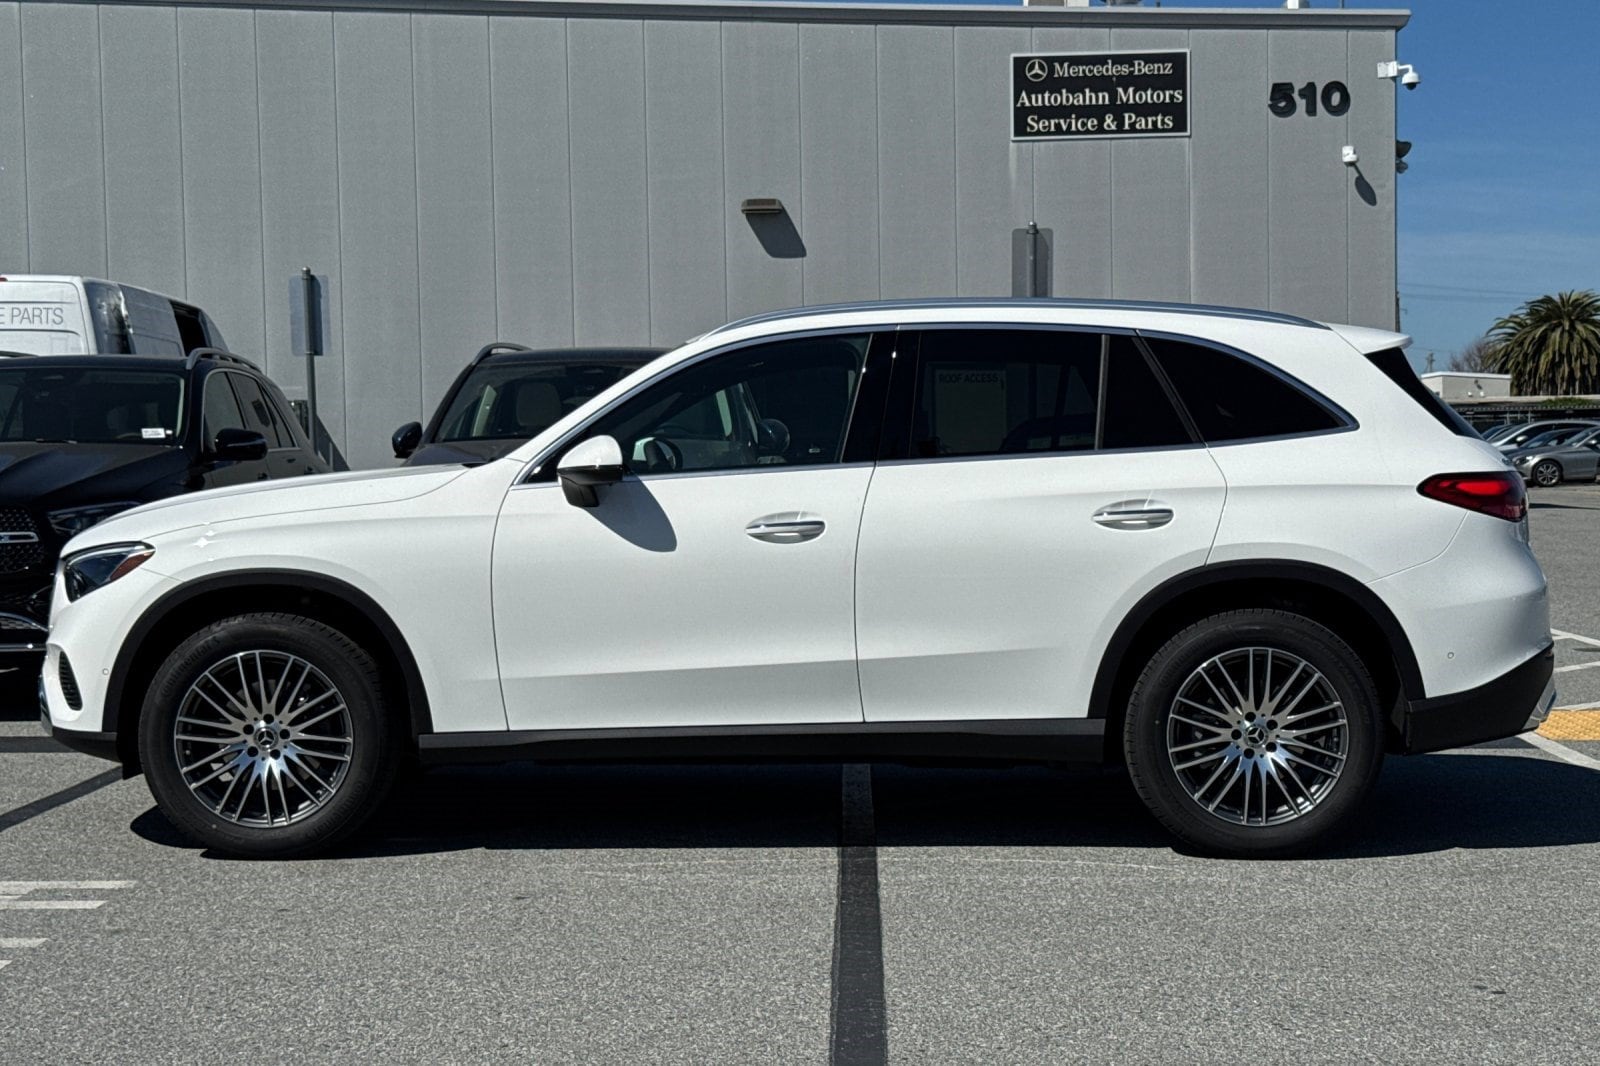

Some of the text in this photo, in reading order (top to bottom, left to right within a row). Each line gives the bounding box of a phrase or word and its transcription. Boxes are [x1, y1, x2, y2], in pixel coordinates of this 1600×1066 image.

[1053, 59, 1173, 78] Mercedes-Benz
[1016, 86, 1183, 107] Autobahn Motors
[1267, 80, 1351, 118] 510
[1026, 112, 1174, 132] Service & Parts
[11, 307, 64, 325] PARTS
[939, 373, 998, 383] ROOF ACCESS
